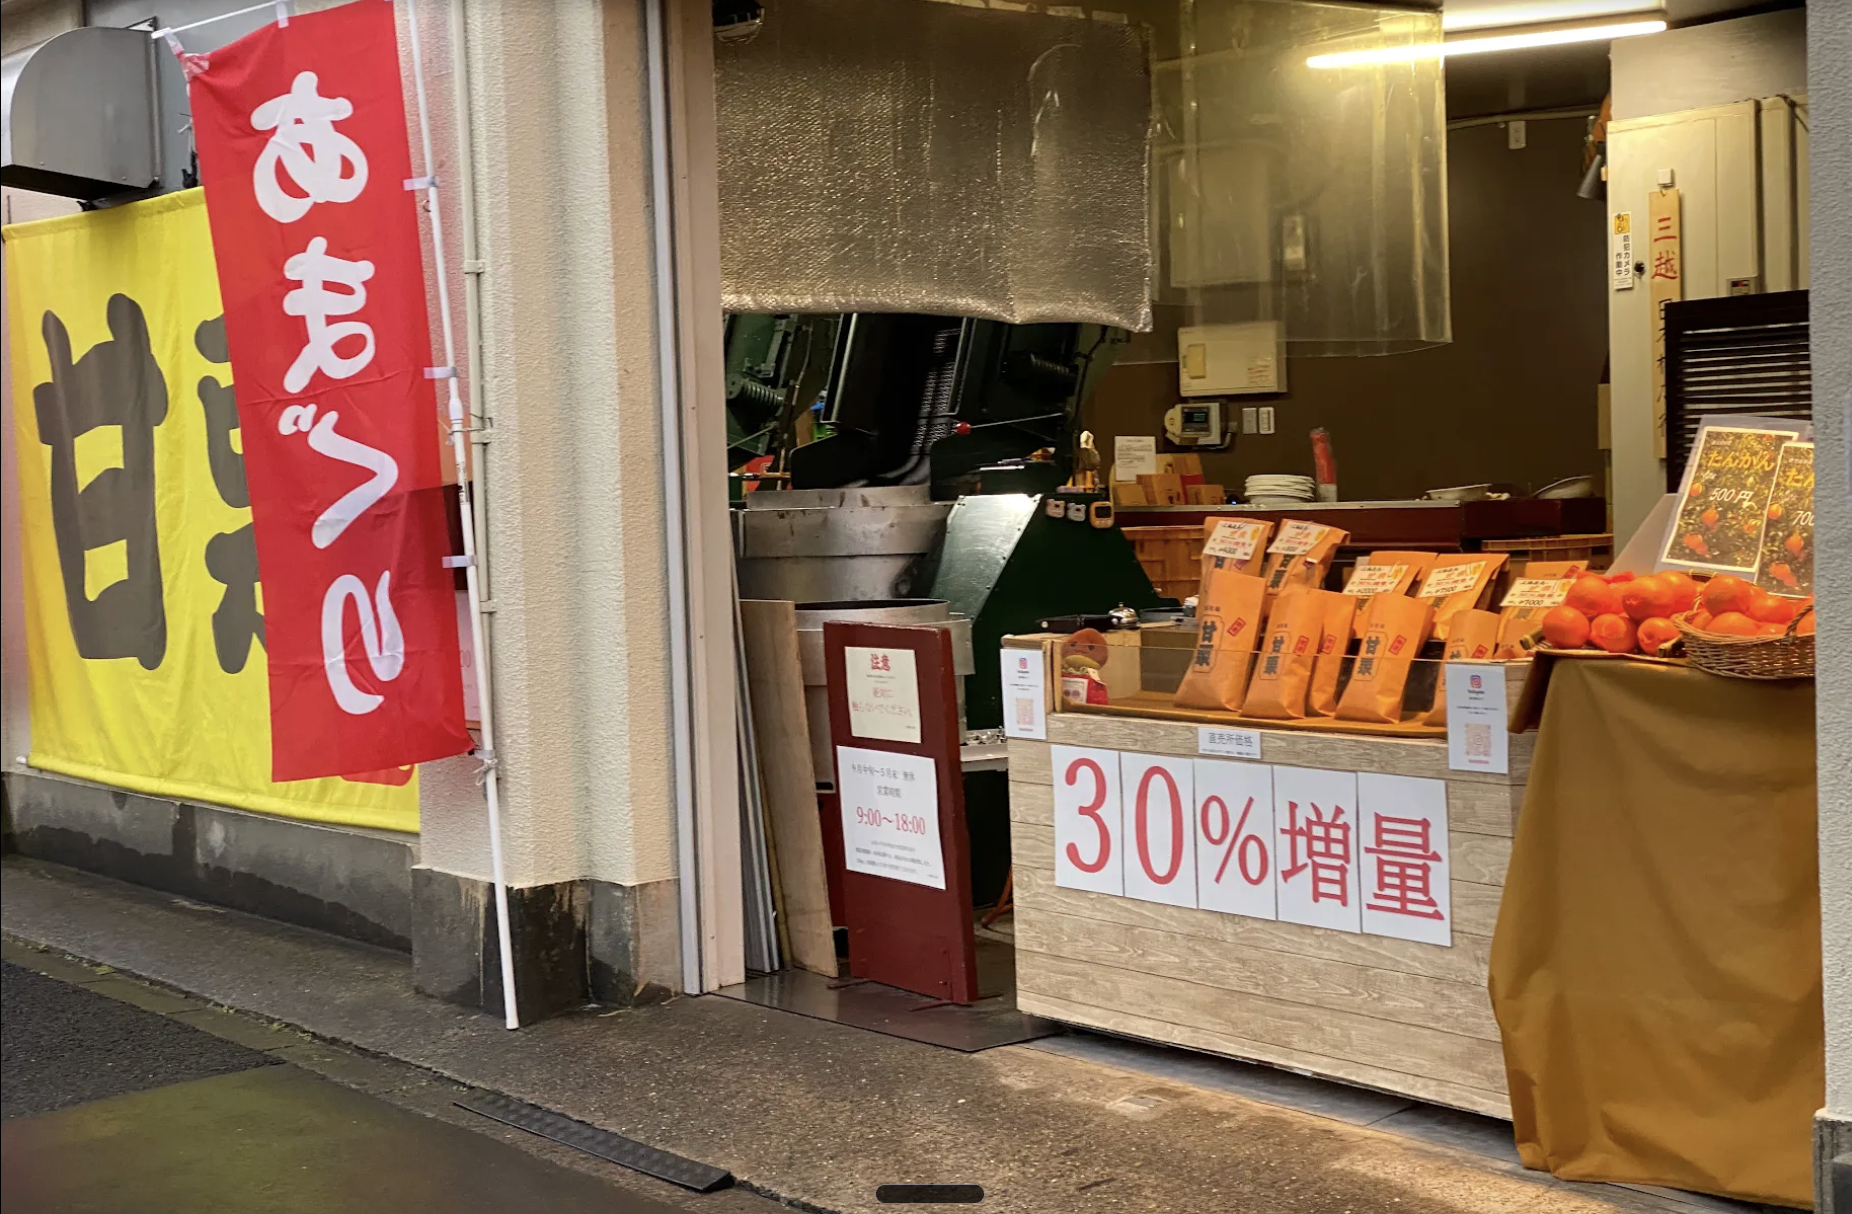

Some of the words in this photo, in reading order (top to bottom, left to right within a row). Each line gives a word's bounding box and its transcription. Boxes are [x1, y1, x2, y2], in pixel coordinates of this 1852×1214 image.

[1623, 234, 1631, 276] 防犯カメラ
[1651, 216, 1678, 279] 三越
[1065, 757, 1444, 921] 30%増量
